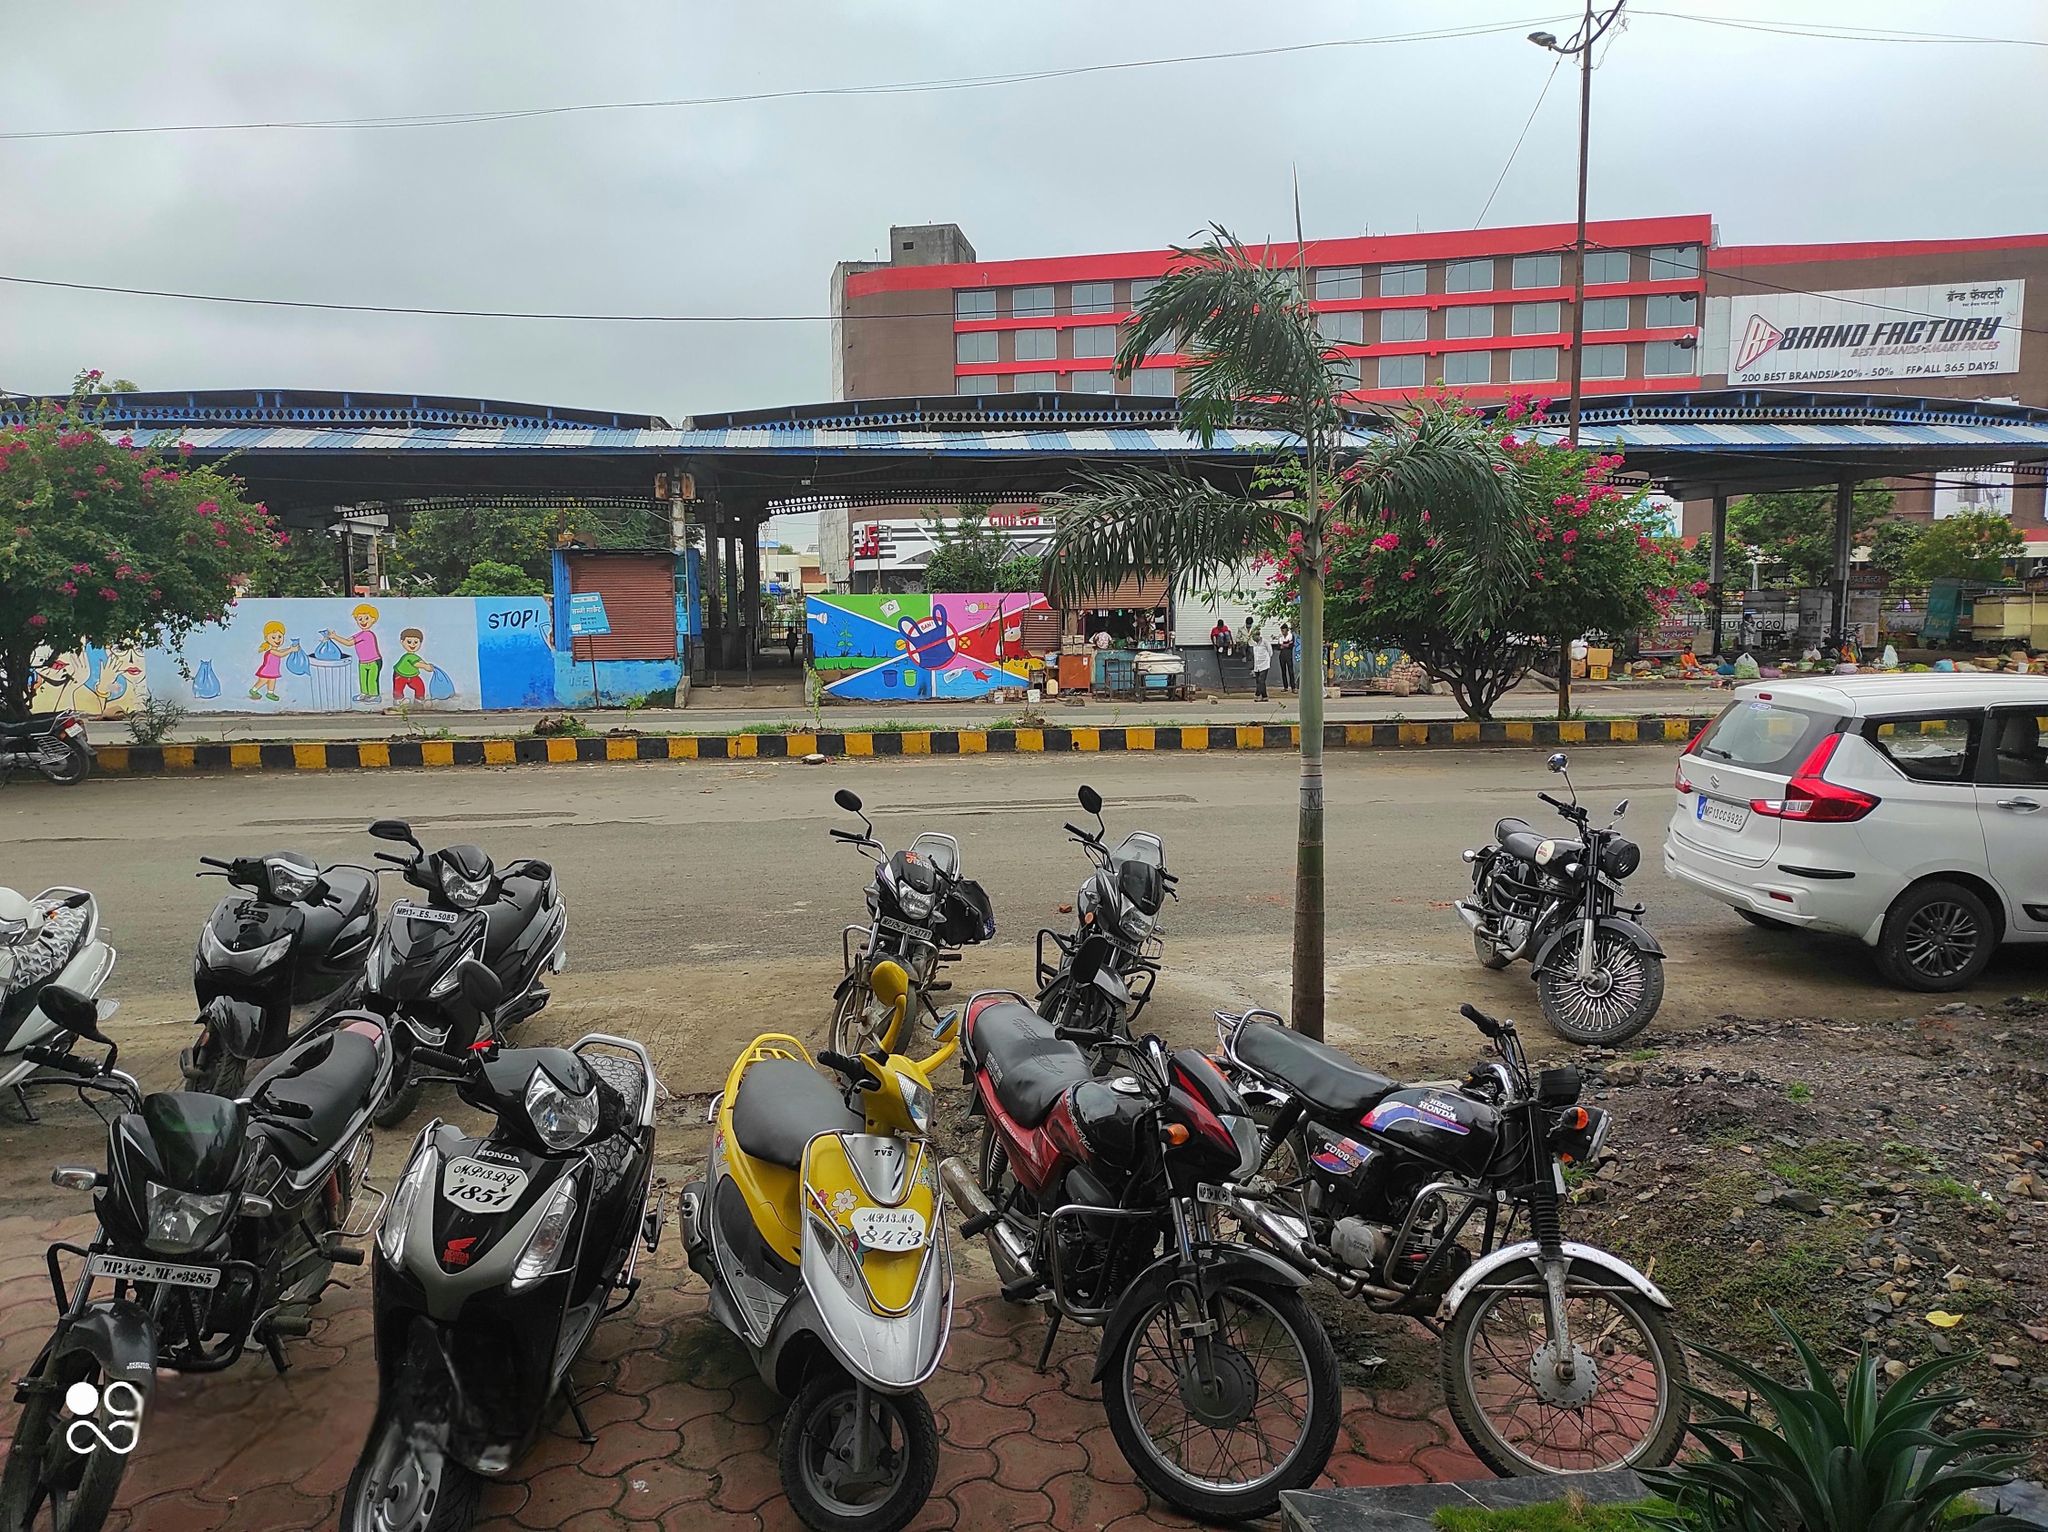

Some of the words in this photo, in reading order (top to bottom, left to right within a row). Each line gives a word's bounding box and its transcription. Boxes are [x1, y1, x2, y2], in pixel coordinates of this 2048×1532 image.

[1778, 324, 1870, 350] BRAND
[1870, 316, 2002, 346] FACTORY
[1851, 347, 1874, 357] BEST
[1877, 344, 1922, 356] BRANDS
[1962, 340, 2000, 351] PRICES
[1741, 373, 1760, 382] 200
[1764, 372, 1786, 381] BEST
[1840, 369, 1862, 378] 20%
[1871, 367, 1894, 377] 50%
[1923, 364, 1941, 373] ALL
[1944, 363, 1965, 372] 365
[1968, 361, 1999, 371] DAYS!
[488, 609, 539, 629] STOP!
[1417, 1100, 1458, 1122] HONDA
[1430, 1098, 1454, 1111] HERO
[476, 1149, 520, 1164] HONDA
[874, 1149, 893, 1157] TVS
[448, 1184, 513, 1206] 1851
[860, 1229, 923, 1246] 8473
